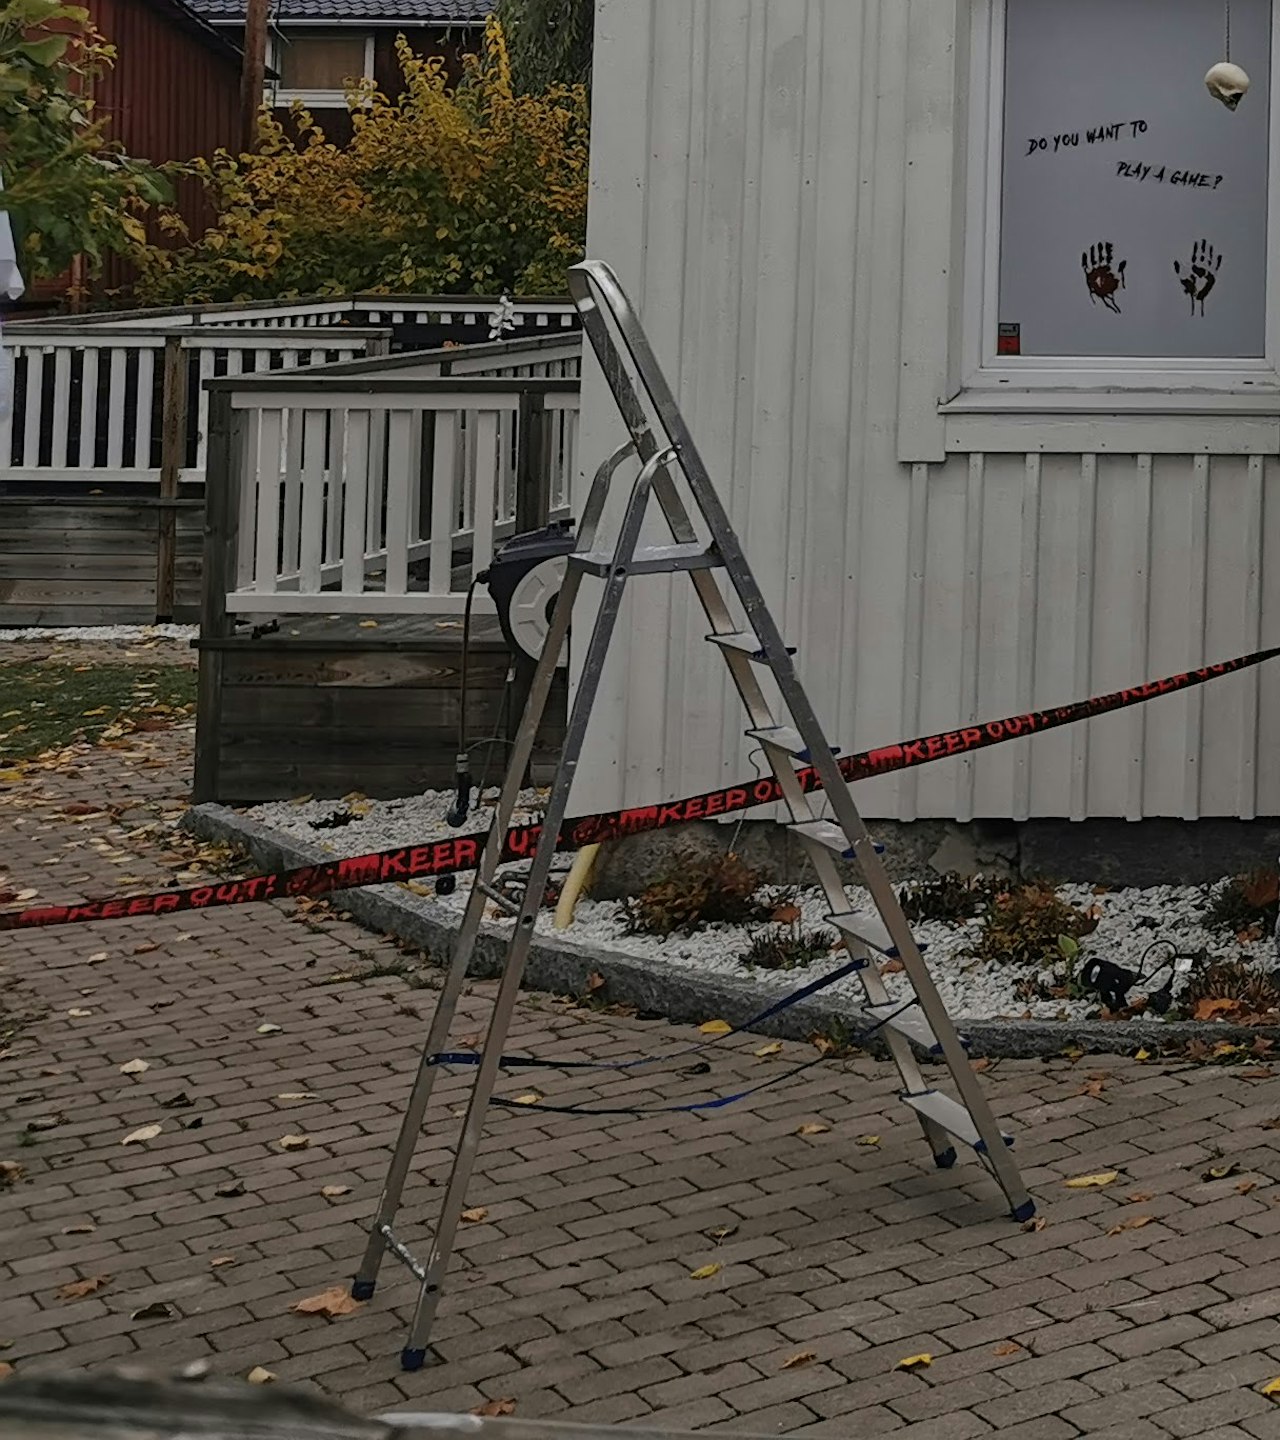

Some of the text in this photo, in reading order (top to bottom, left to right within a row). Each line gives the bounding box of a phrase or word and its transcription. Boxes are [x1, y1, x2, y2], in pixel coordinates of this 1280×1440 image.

[1025, 119, 1147, 156] DO YOU WANT TO
[1116, 161, 1223, 190] PLAY A GAME?
[67, 894, 180, 920] KEEP
[190, 874, 277, 908] OUT!
[380, 839, 477, 879] KEEP
[659, 789, 748, 826] KEEP
[902, 727, 981, 764] KEEP
